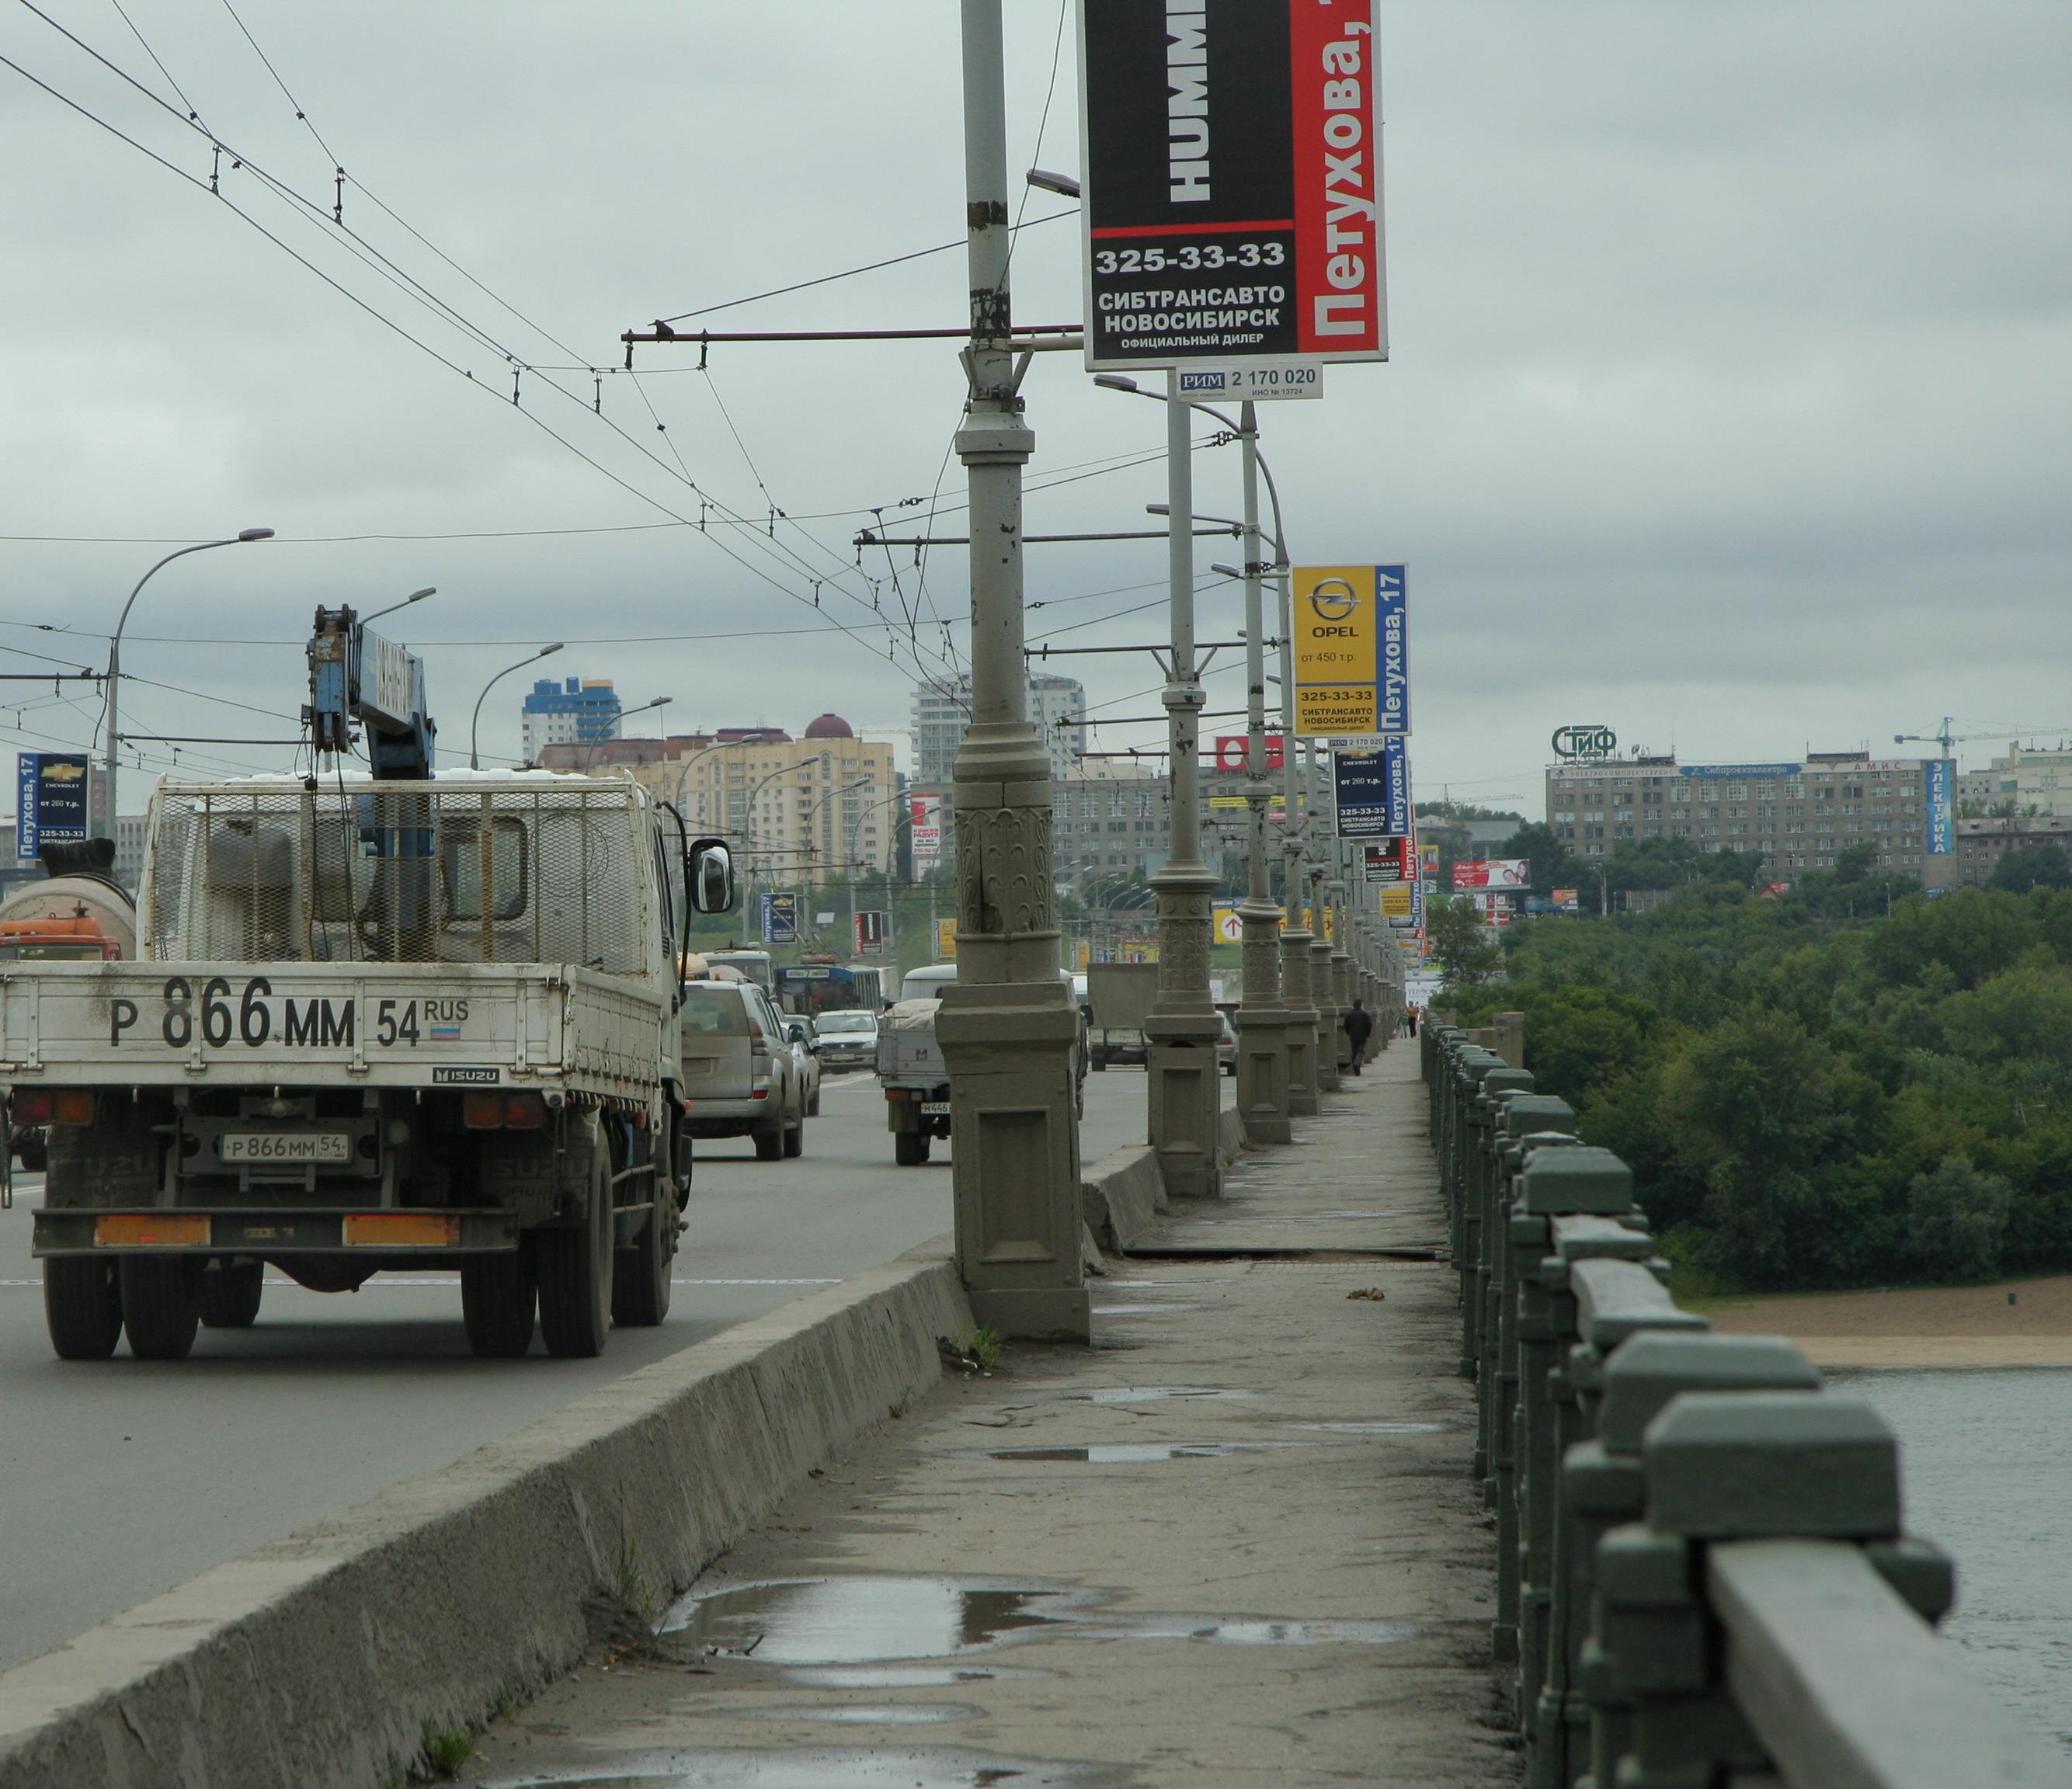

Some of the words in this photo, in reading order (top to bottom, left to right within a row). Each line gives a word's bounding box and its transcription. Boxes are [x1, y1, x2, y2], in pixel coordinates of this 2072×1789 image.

[1314, 21, 1375, 336] Петухова,
[1096, 243, 1285, 273] 325-33-33
[1099, 286, 1285, 310] СИБТРАНСАВТО
[1104, 308, 1281, 332] НОВОСИБИРСК
[1121, 333, 1220, 349] ОФИЦИАЛЬНЫЙ
[1222, 333, 1264, 346] ДИЛЕР
[1183, 375, 1222, 388] РИМ
[1232, 371, 1242, 385] 2
[1249, 370, 1278, 385] 170
[1285, 369, 1316, 384] 020
[1380, 573, 1400, 602] 17
[1312, 627, 1359, 637] OPEL
[1302, 654, 1313, 662] от
[1316, 652, 1337, 662] 450
[1382, 607, 1406, 728] Петухова,
[1302, 691, 1373, 702] 325-33-33
[1302, 707, 1373, 716] СИБТРАНСАВТО
[1304, 716, 1371, 724] НОВОСИБИРСК
[1552, 725, 1617, 758] СТИФ
[21, 758, 33, 776] 17
[1854, 762, 1901, 771] АМИС
[1392, 755, 1406, 832] Петухова,
[20, 779, 36, 856] Петухова,
[1931, 763, 1945, 853] ЭЛЕКТРИКА
[111, 999, 138, 1047] Р
[162, 977, 272, 1047] 866
[284, 999, 354, 1047] ММ
[377, 1000, 420, 1047] 54
[424, 1000, 469, 1022] RUS
[451, 1071, 496, 1080] ISUZU
[321, 1137, 340, 1152] 54
